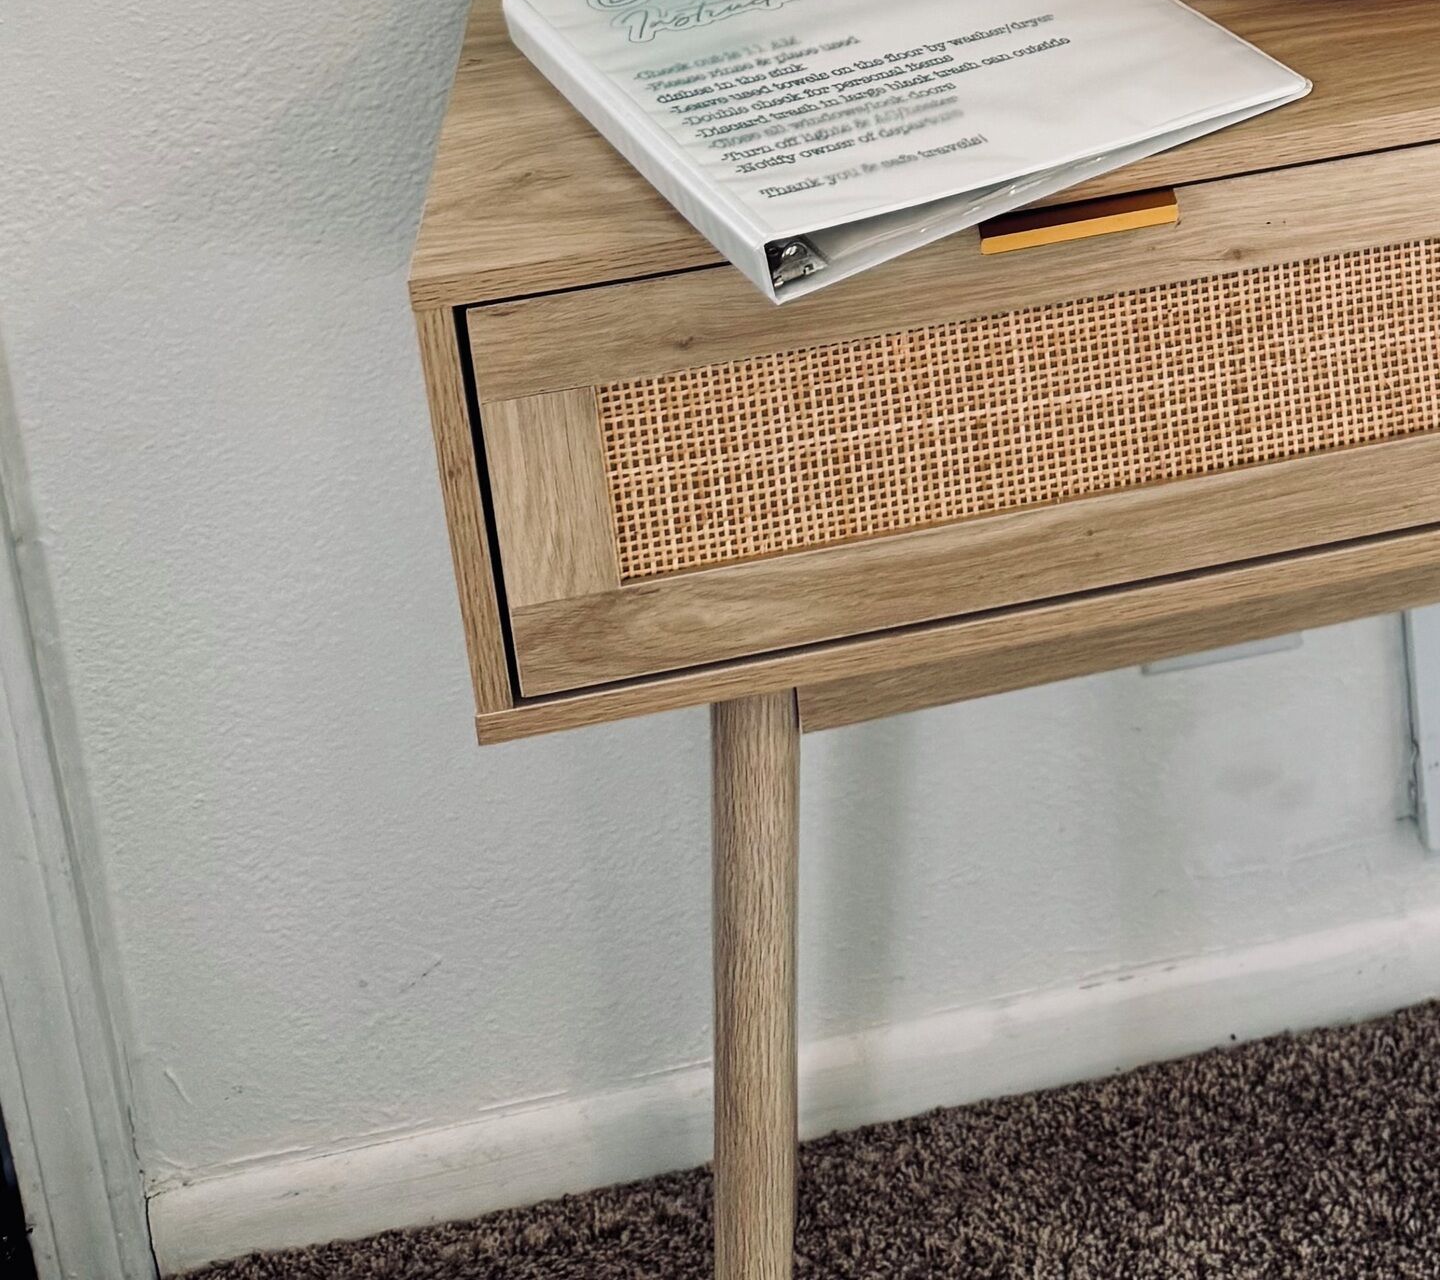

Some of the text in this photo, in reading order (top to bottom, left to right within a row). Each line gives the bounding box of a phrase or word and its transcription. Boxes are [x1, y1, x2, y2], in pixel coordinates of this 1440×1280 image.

[714, 80, 735, 91] in
[735, 73, 767, 87] the
[769, 63, 808, 78] sink
[729, 85, 773, 101] used
[773, 71, 830, 90] towels
[831, 66, 854, 77] on
[854, 58, 885, 72] the
[884, 47, 924, 63] floor
[923, 42, 947, 54] by
[948, 14, 1054, 46] washer/dryer
[751, 93, 805, 111] check
[802, 86, 830, 97] for
[832, 67, 908, 90] personal
[905, 54, 954, 72] items
[770, 102, 820, 120] trash
[885, 74, 935, 90] black
[934, 62, 981, 77] trash
[982, 53, 1013, 65] can
[1013, 37, 1071, 57] outside
[800, 140, 855, 158] owner
